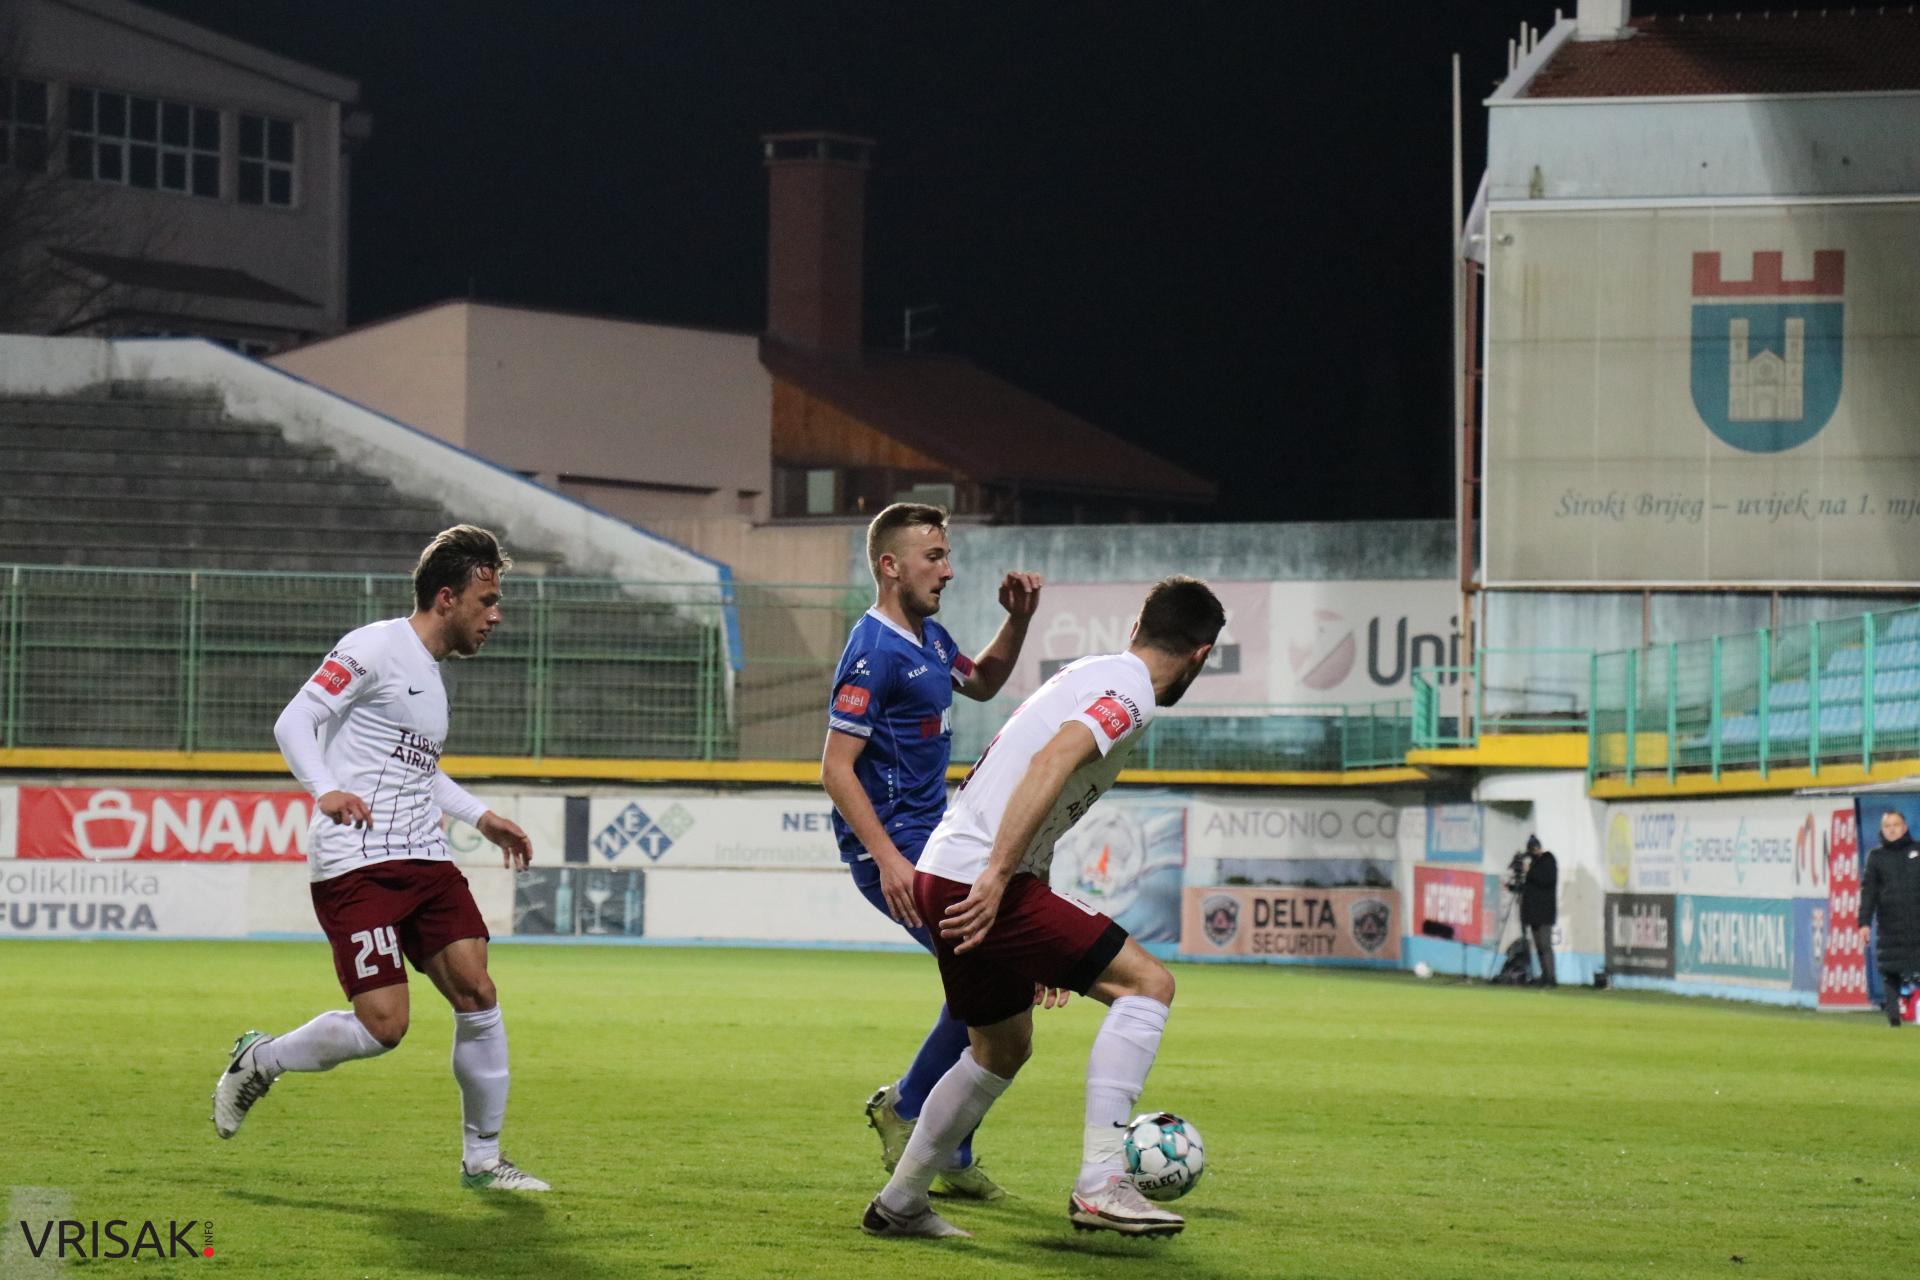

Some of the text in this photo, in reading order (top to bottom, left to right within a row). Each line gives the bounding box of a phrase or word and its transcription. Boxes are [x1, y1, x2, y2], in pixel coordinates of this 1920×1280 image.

[1554, 488, 1626, 522] Široki
[1633, 490, 1705, 524] Brijeg
[1737, 489, 1816, 524] uvijek
[1818, 498, 1847, 515] na
[1368, 615, 1460, 686] Uni
[152, 797, 308, 855] NAM
[1205, 809, 1343, 839] ANTONIO
[0, 865, 159, 895] oliklinika
[1253, 898, 1337, 930] DELTA
[350, 925, 401, 980] 24
[1252, 932, 1336, 955] SECURITY
[1138, 1169, 1183, 1191] SELECT
